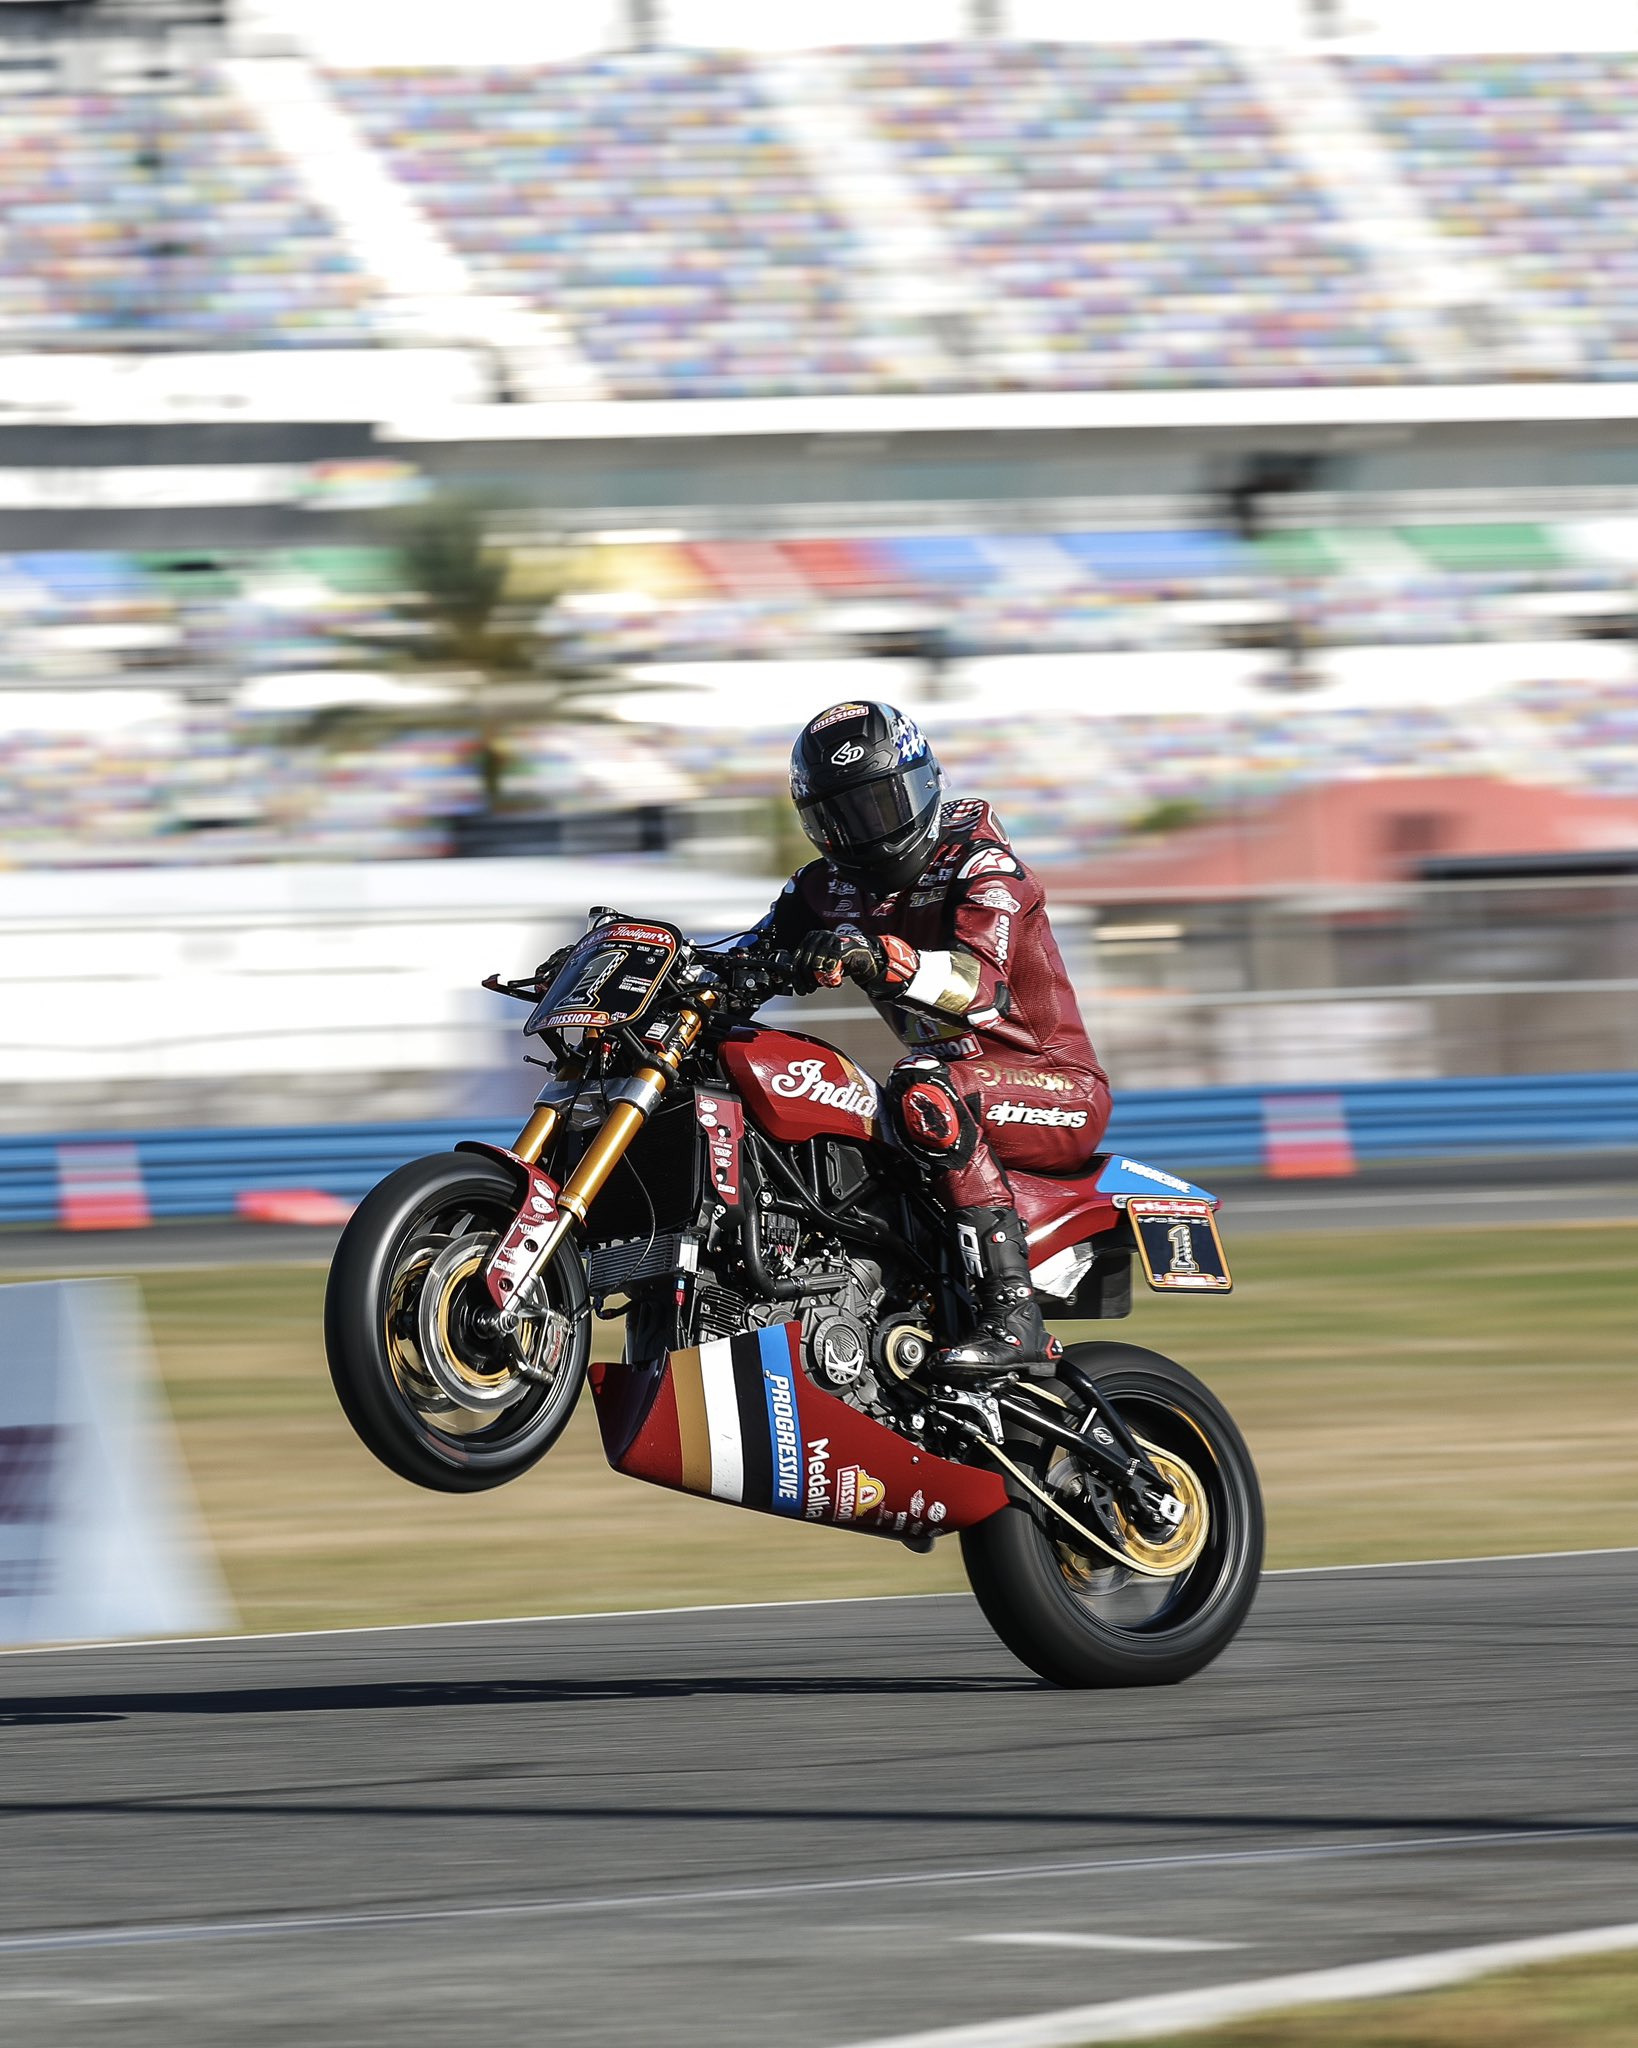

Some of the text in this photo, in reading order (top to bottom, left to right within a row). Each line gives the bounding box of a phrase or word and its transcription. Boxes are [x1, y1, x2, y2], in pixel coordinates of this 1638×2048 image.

[812, 706, 867, 732] mission
[613, 925, 658, 941] Hooligan
[995, 914, 1010, 965] dallia
[547, 1013, 592, 1026] mission
[771, 1058, 880, 1119] India
[985, 1100, 1088, 1129] alpinestars
[1167, 1224, 1200, 1273] 1
[769, 1374, 797, 1500] PROGRESSIVE
[805, 1437, 832, 1519] Medallia
[838, 1470, 856, 1522] mission
